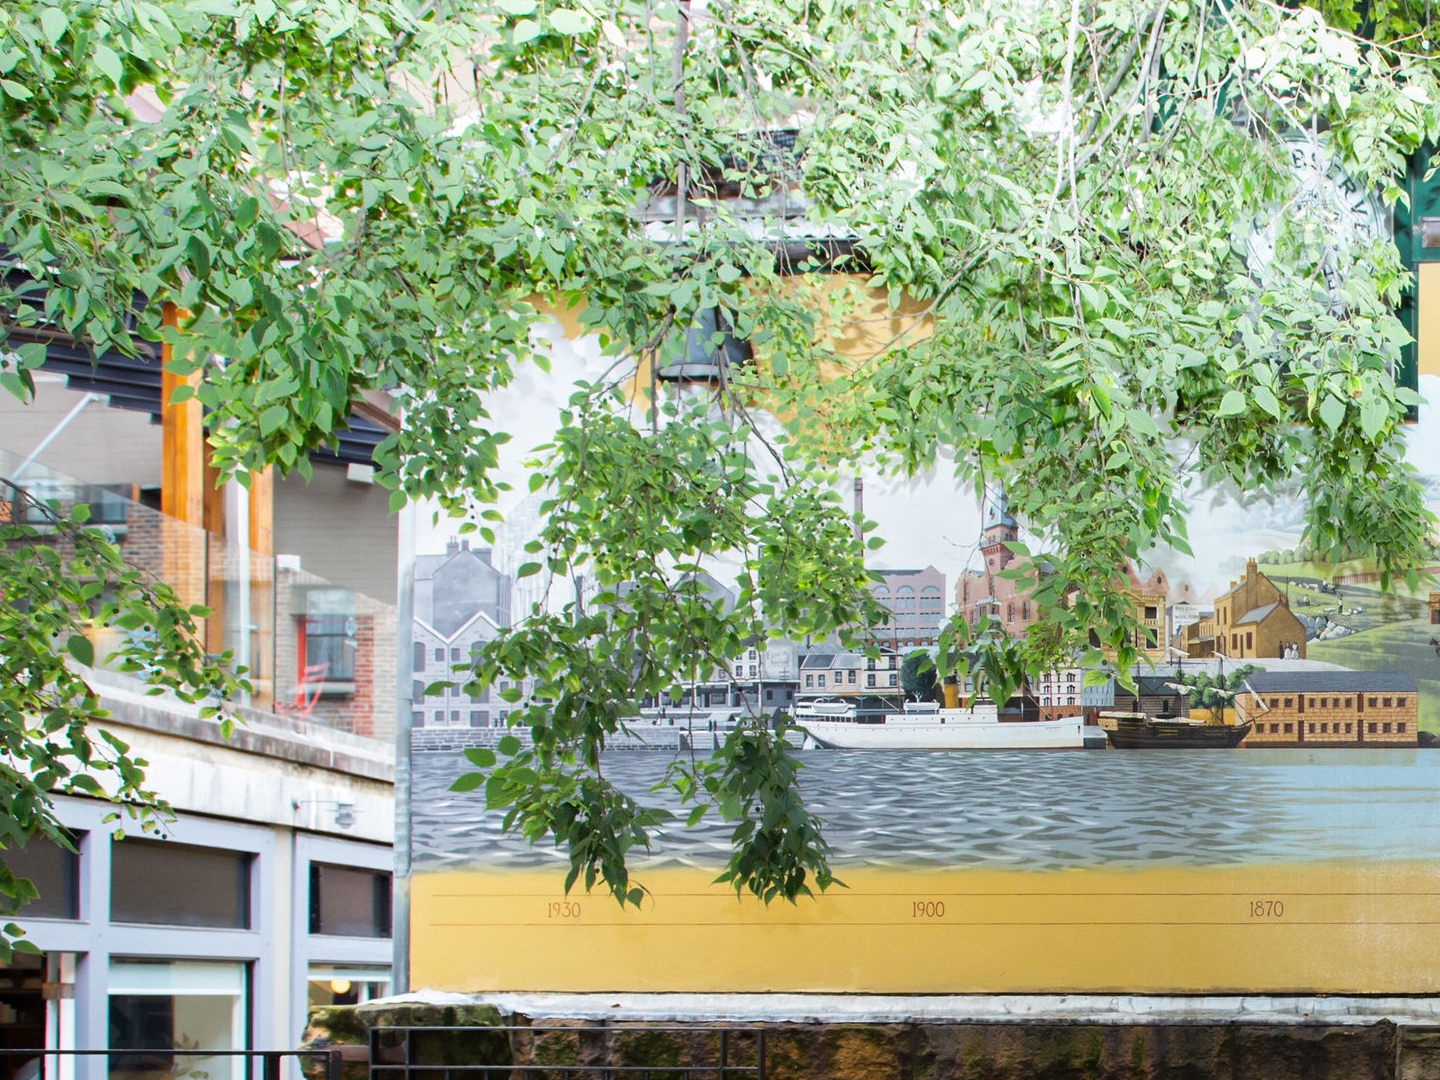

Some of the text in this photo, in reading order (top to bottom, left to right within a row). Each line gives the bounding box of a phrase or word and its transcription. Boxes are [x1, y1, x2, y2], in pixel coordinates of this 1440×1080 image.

[547, 901, 582, 919] 1930
[912, 901, 945, 918] 1900
[1249, 900, 1284, 917] 1870
